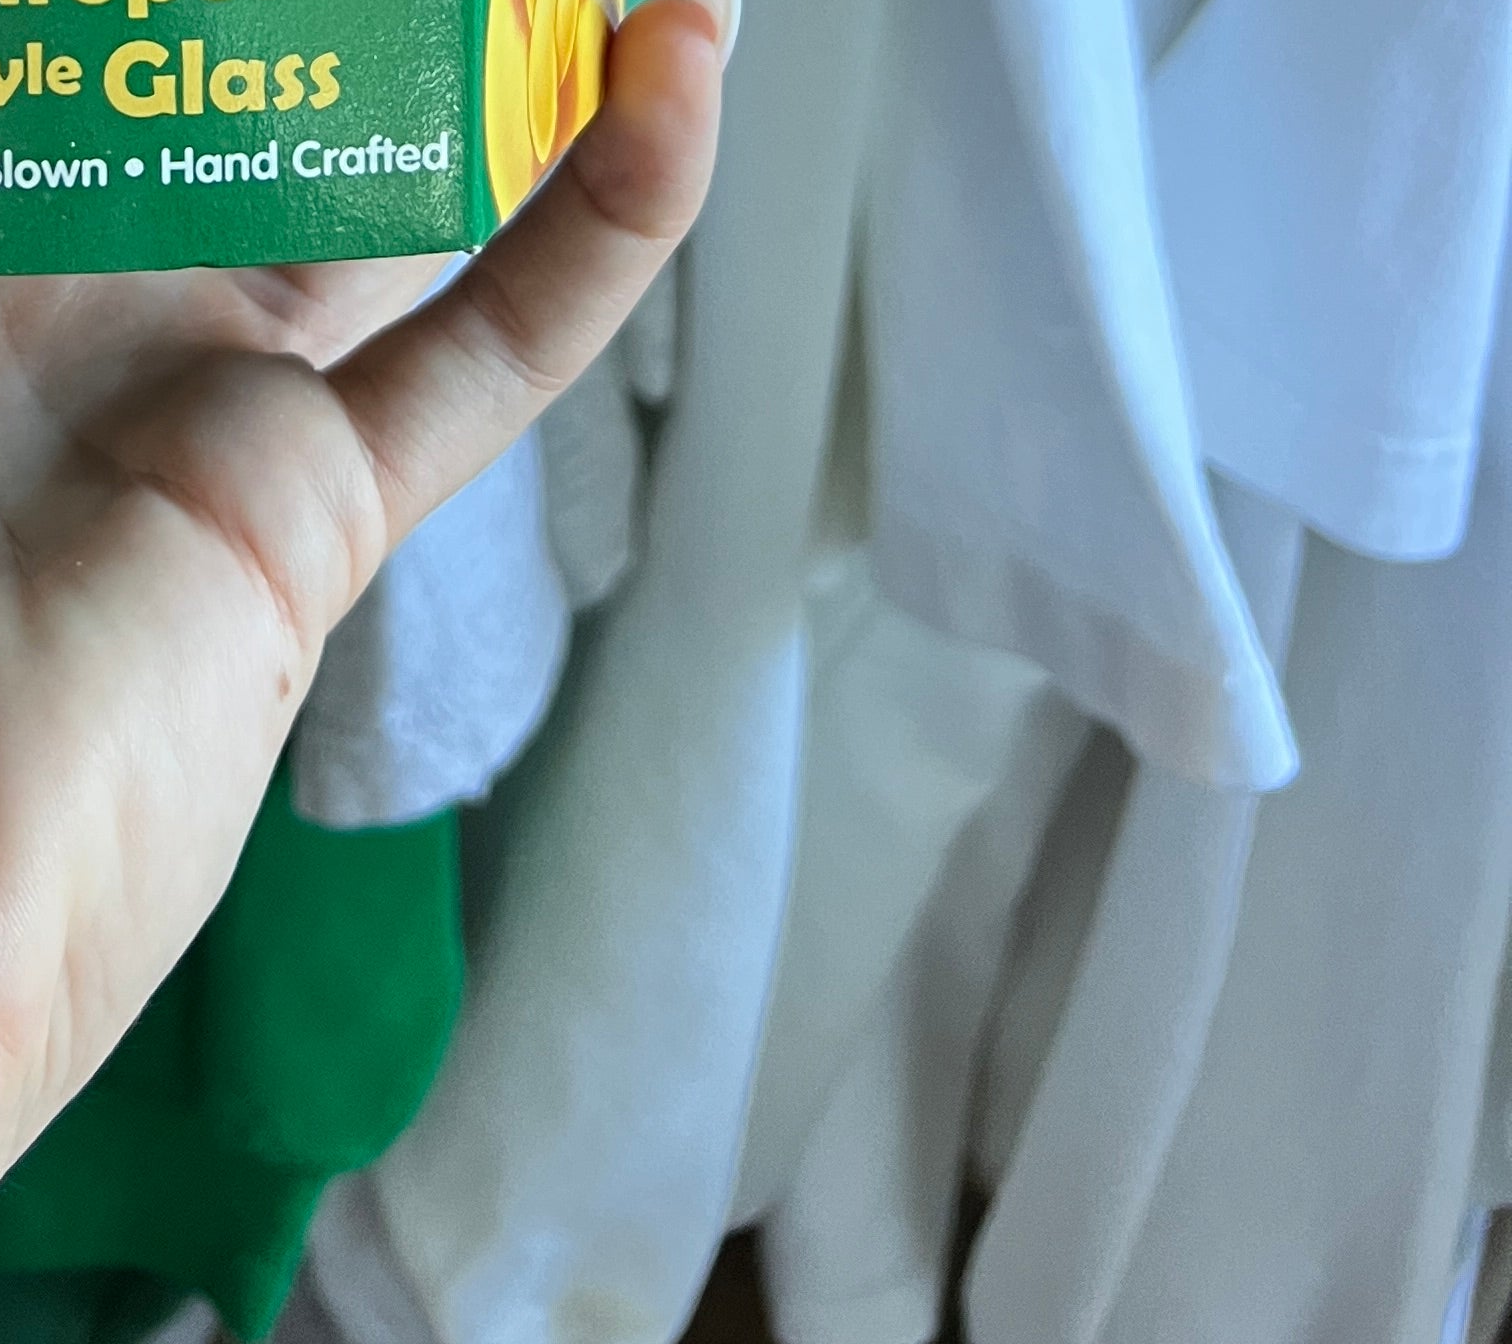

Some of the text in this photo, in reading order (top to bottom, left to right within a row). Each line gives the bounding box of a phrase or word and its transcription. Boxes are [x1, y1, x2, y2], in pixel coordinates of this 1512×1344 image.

[103, 38, 341, 118] Glass
[160, 141, 278, 185] Hand
[291, 132, 450, 179] Crafted
